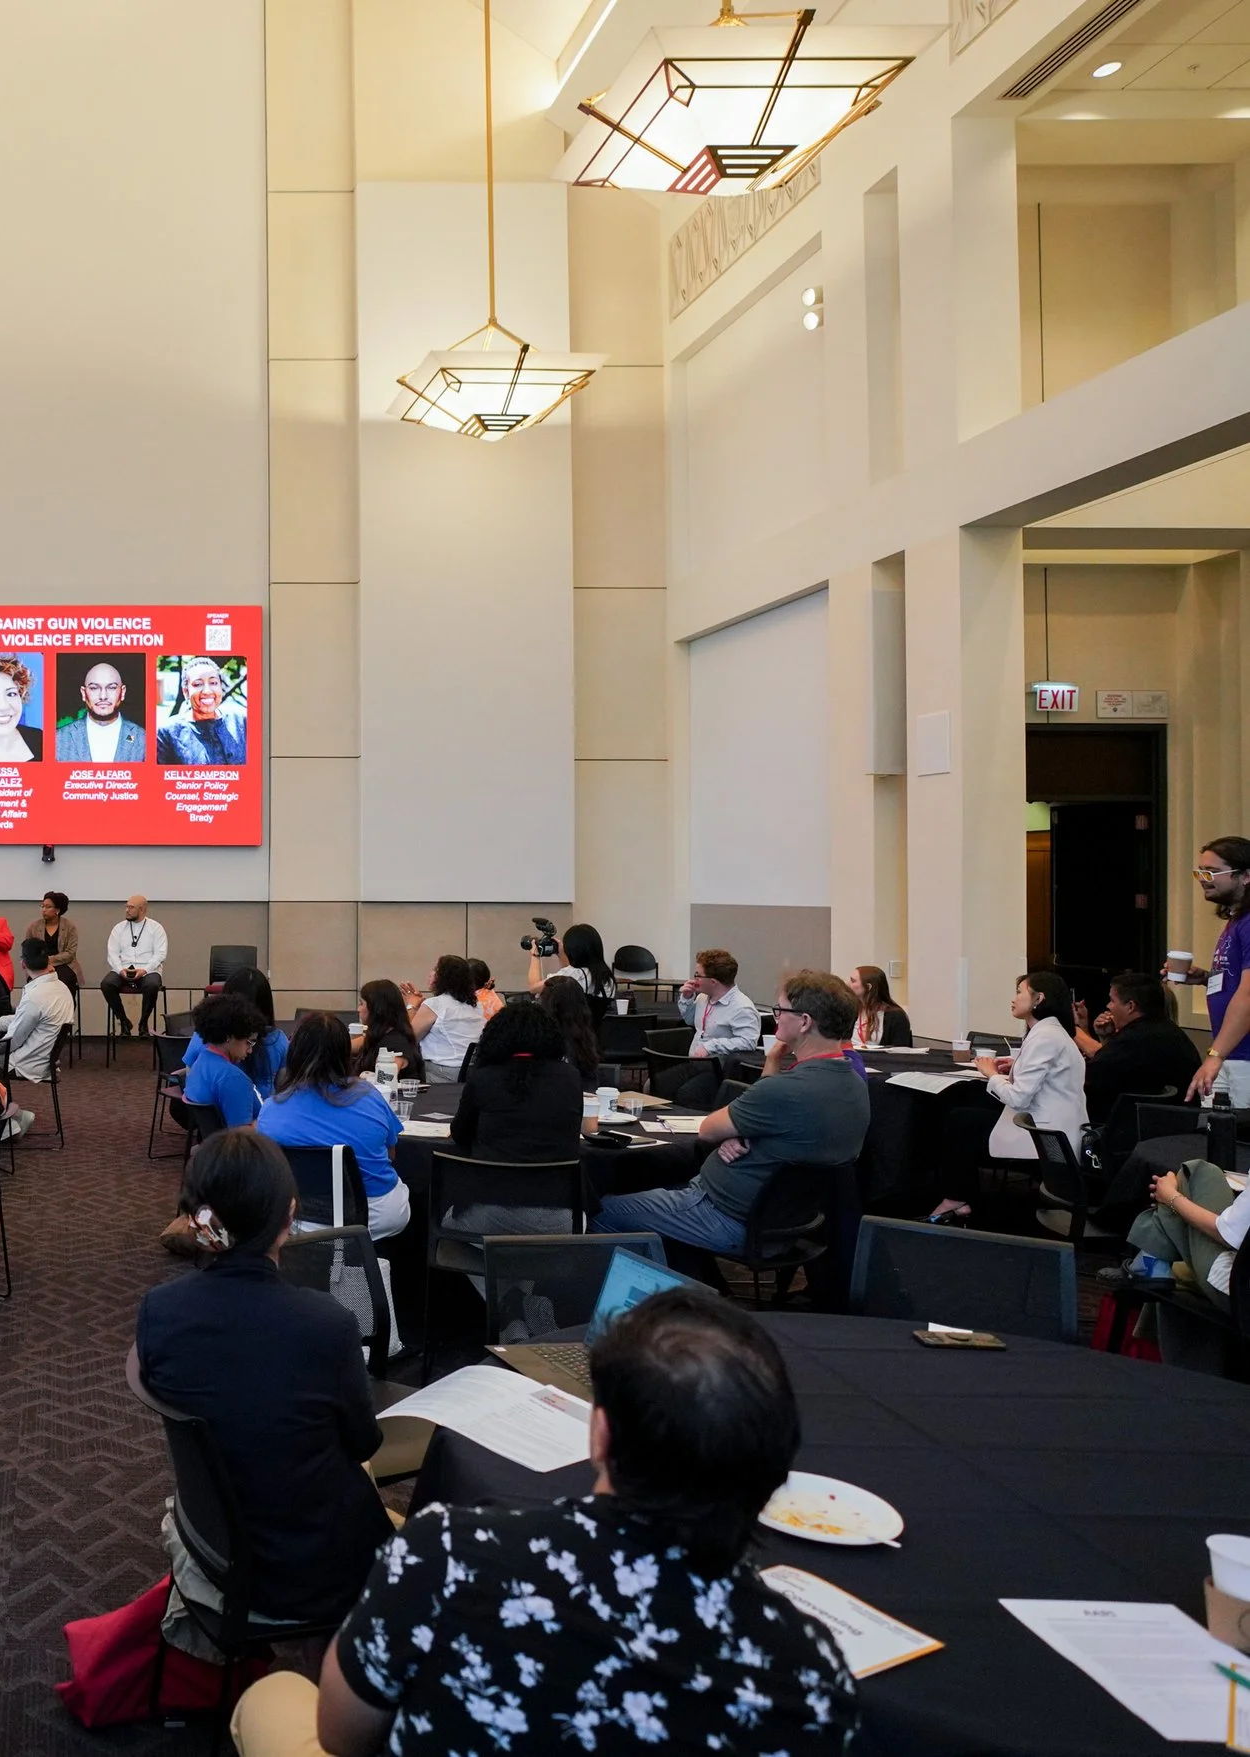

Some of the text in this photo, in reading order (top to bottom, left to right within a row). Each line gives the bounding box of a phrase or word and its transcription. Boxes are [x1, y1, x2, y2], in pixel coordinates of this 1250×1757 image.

[47, 617, 78, 630] GUN
[81, 617, 152, 630] VIOLENCE
[2, 634, 72, 647] VIOLENCE
[75, 633, 164, 646] PREVENTION
[1038, 689, 1076, 710] EXIT
[70, 770, 132, 780] JOSE ALFARO
[163, 771, 239, 780] KELLY SAMPSON
[64, 781, 138, 790] Executive Director
[175, 782, 229, 791] Senior Policy
[23, 788, 33, 797] of
[62, 792, 139, 801] Community Justice
[202, 792, 238, 802] Strategic
[20, 799, 27, 808] &
[176, 803, 228, 812] Engagement
[1, 810, 28, 818] Affairs
[189, 813, 214, 823] Brady
